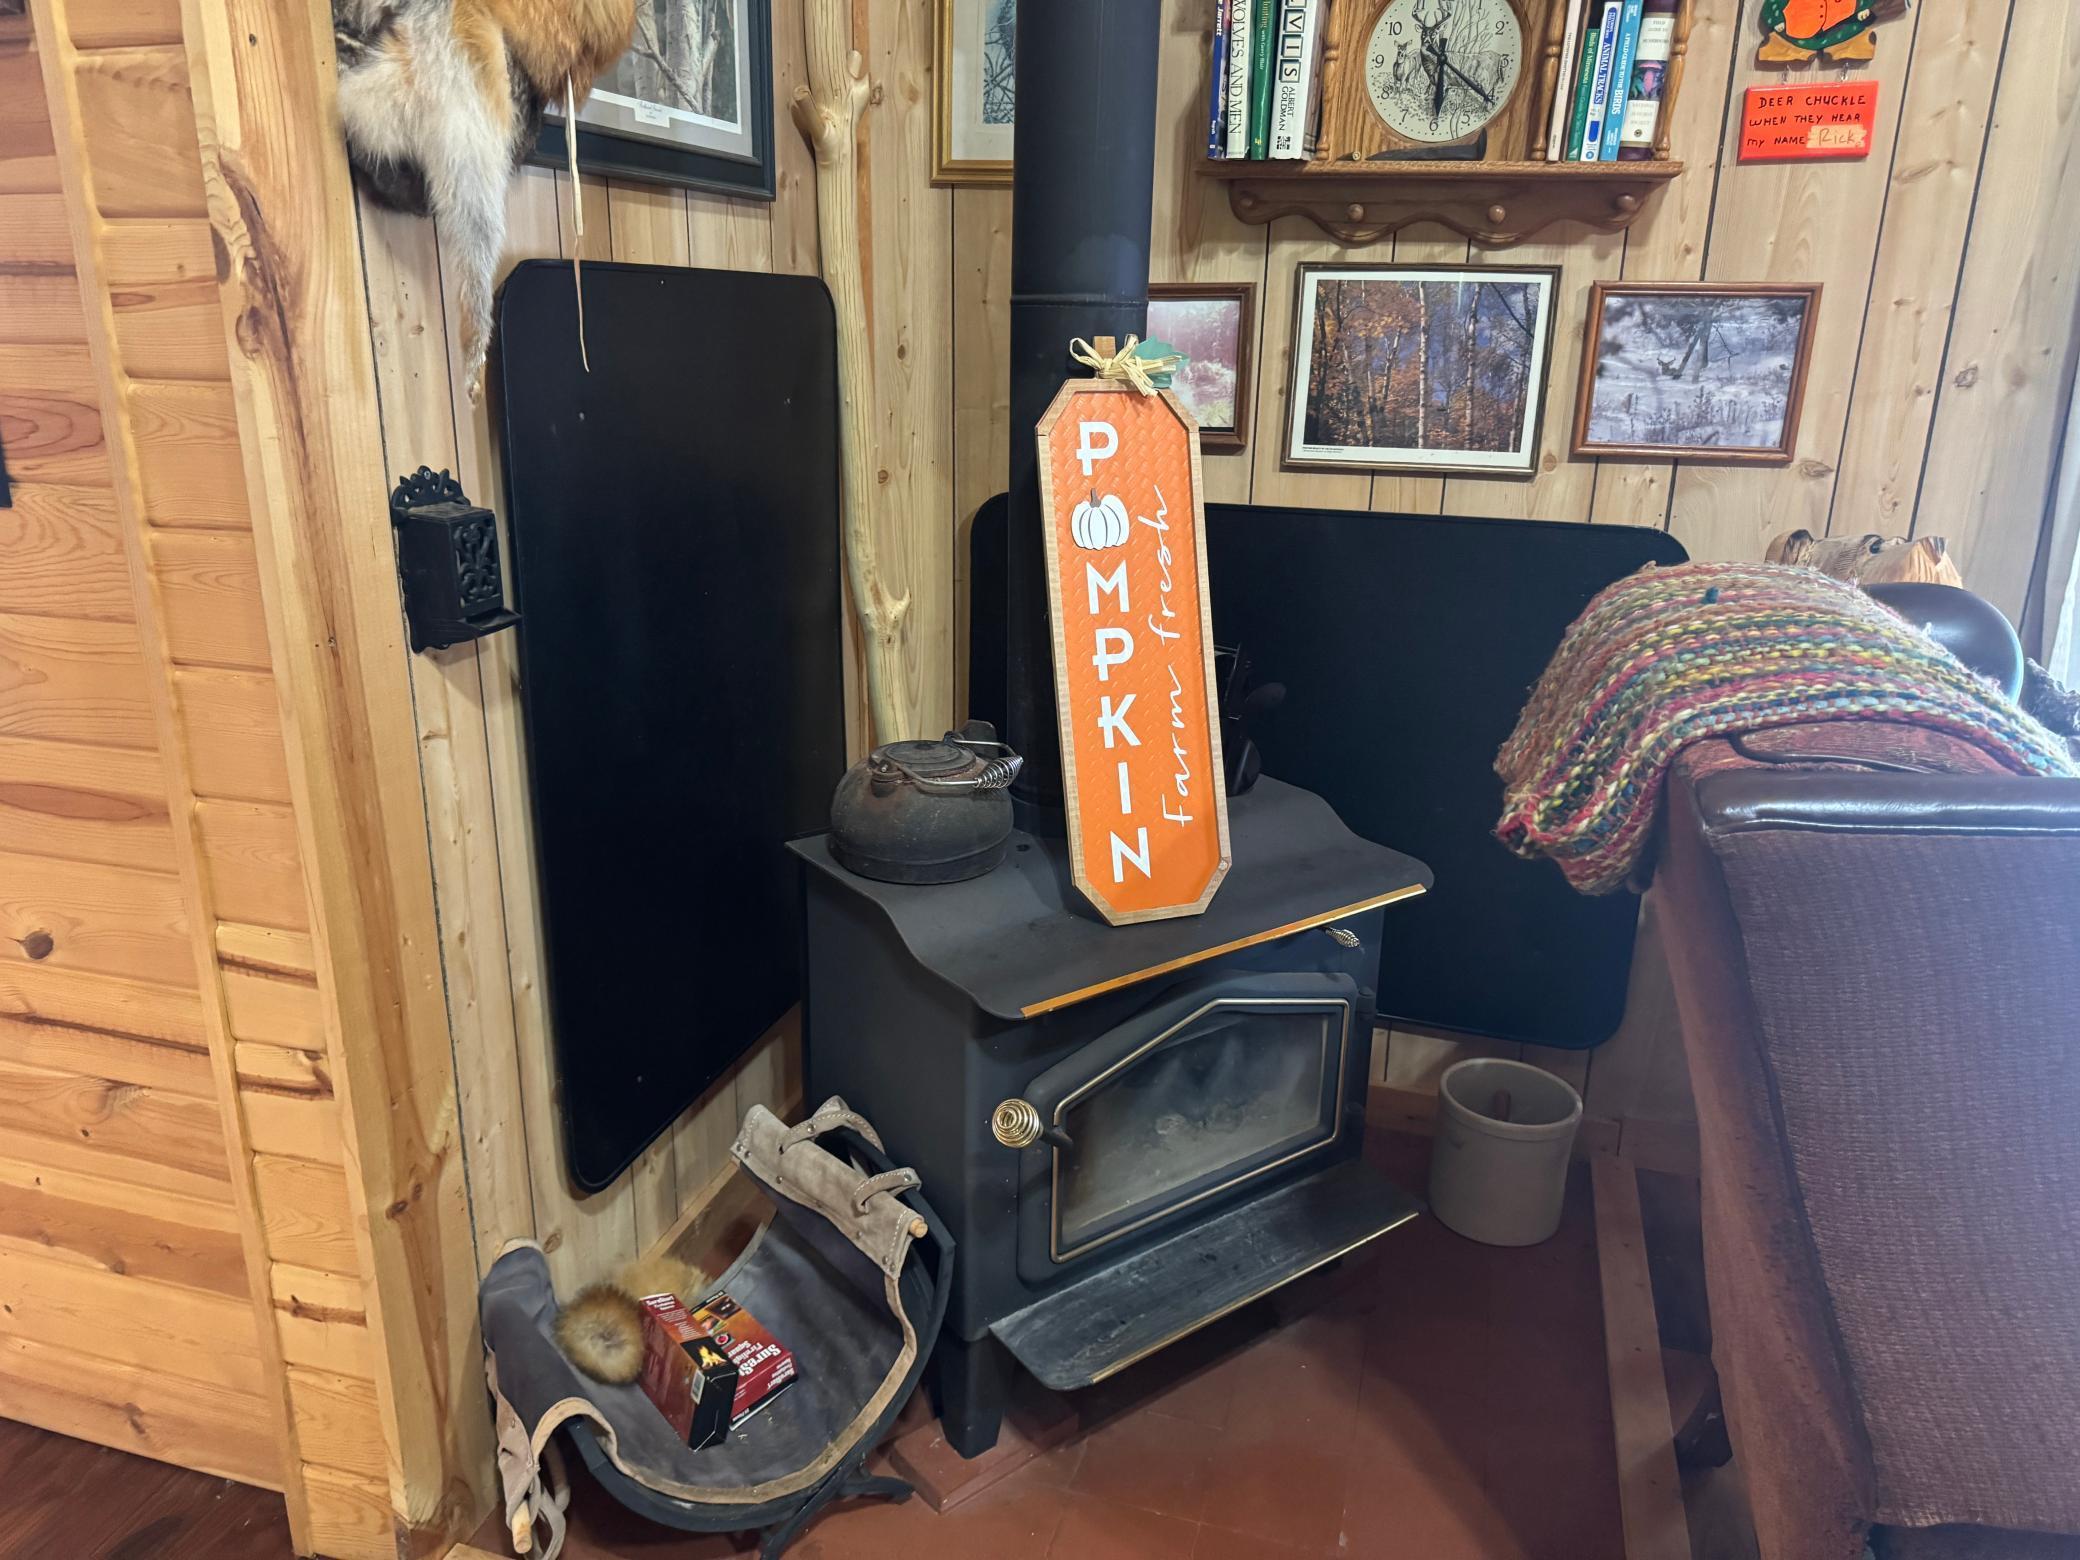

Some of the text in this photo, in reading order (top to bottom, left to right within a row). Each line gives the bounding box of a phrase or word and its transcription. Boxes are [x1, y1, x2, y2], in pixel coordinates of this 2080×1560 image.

[1388, 21, 1402, 35] 10
[1495, 21, 1505, 35] 2
[1284, 0, 1302, 77] VIS
[1589, 32, 1597, 47] Birds
[1374, 54, 1385, 68] 9
[1501, 53, 1510, 68] 3
[1600, 42, 1611, 73] ANIMAL
[1230, 64, 1243, 97] AND
[1381, 86, 1391, 100] 8
[1595, 73, 1607, 104] TRACKS
[1278, 86, 1288, 131] GOLDMAN
[1286, 86, 1295, 117] ALBERT
[1612, 90, 1624, 115] BIRDS
[1758, 95, 1866, 108] DEER CHUCKLE
[1229, 100, 1243, 134] MEN
[1401, 109, 1409, 123] 7
[1462, 111, 1471, 125] 5
[1749, 113, 1861, 126] WHEN THEY HEAR
[1429, 118, 1439, 132] 6
[1774, 136, 1805, 145] NAME
